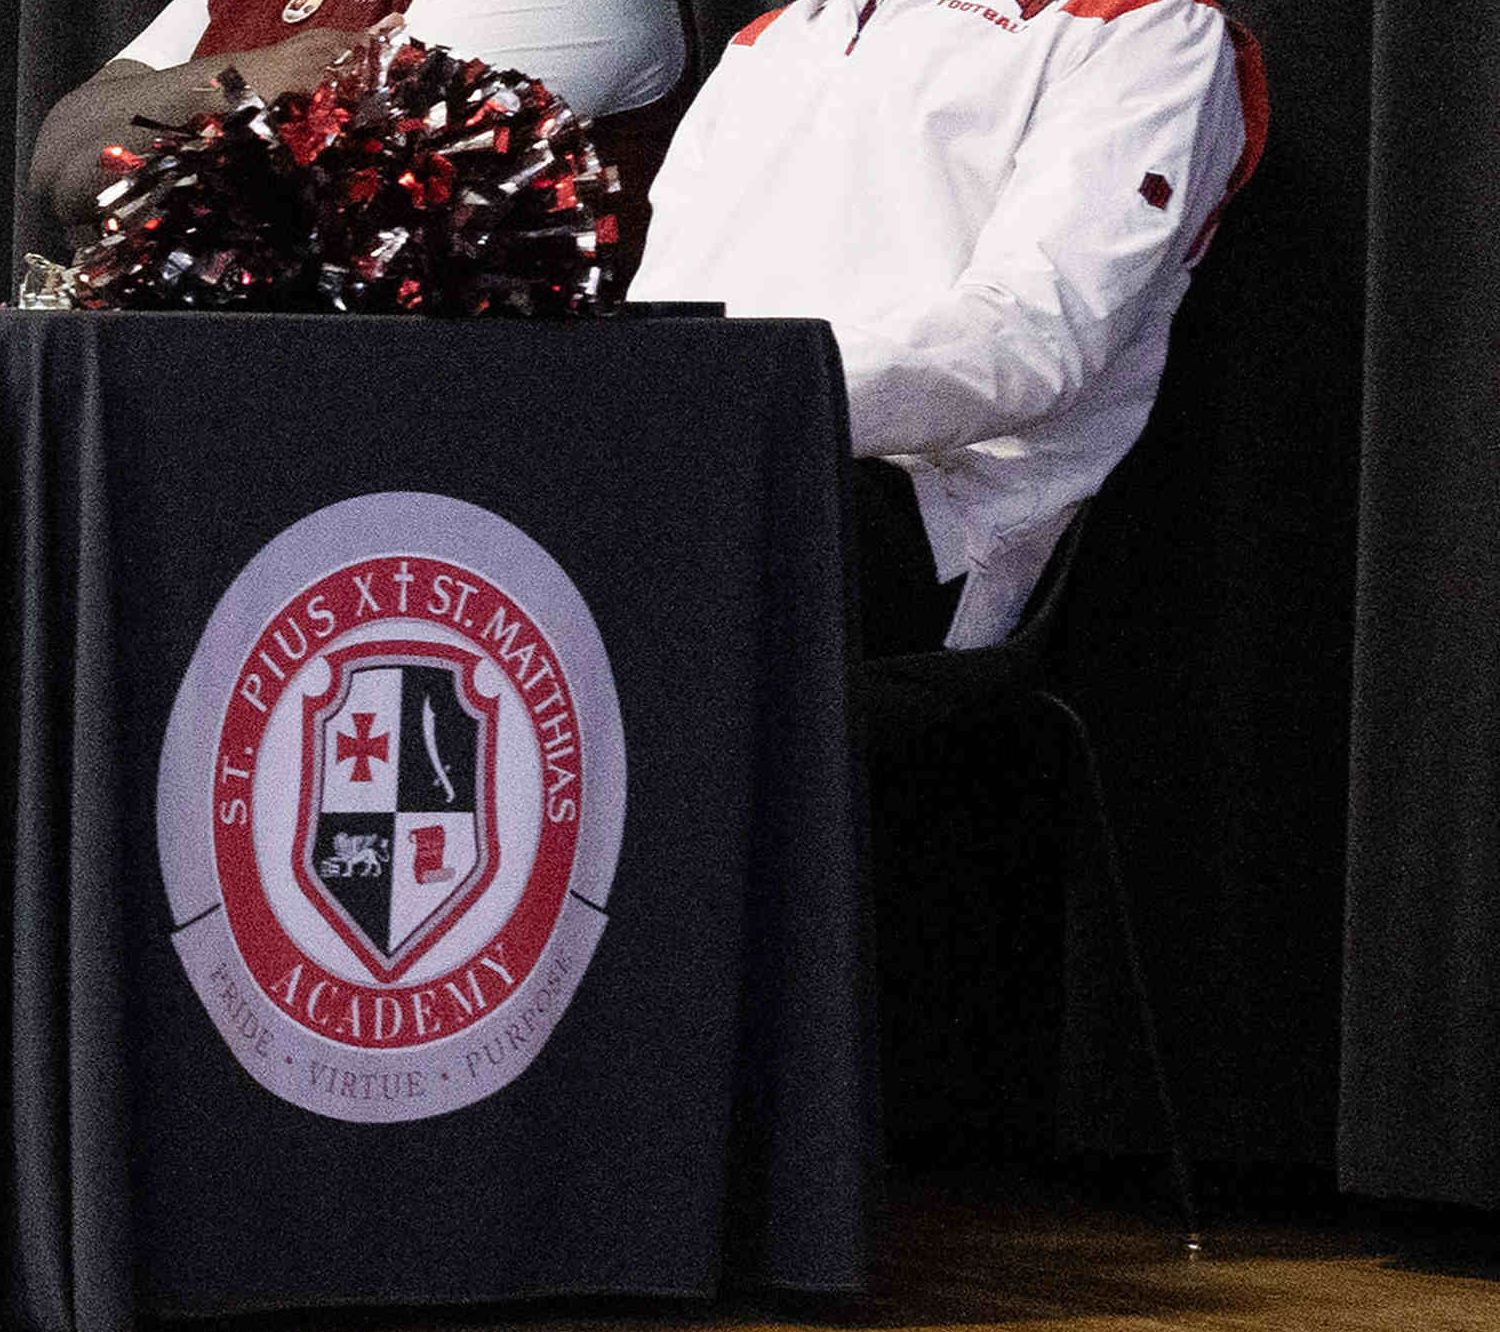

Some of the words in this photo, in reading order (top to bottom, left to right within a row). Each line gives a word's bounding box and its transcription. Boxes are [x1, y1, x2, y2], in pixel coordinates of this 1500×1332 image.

[220, 743, 255, 828] ST.
[241, 592, 338, 717] PIUS
[354, 572, 380, 614] X
[426, 573, 474, 631] ST.
[482, 604, 578, 827] MATTHIAS
[271, 942, 521, 1043] ACADEMY
[306, 1062, 426, 1101] VIRTUE
[465, 946, 573, 1081] PURPOSE
